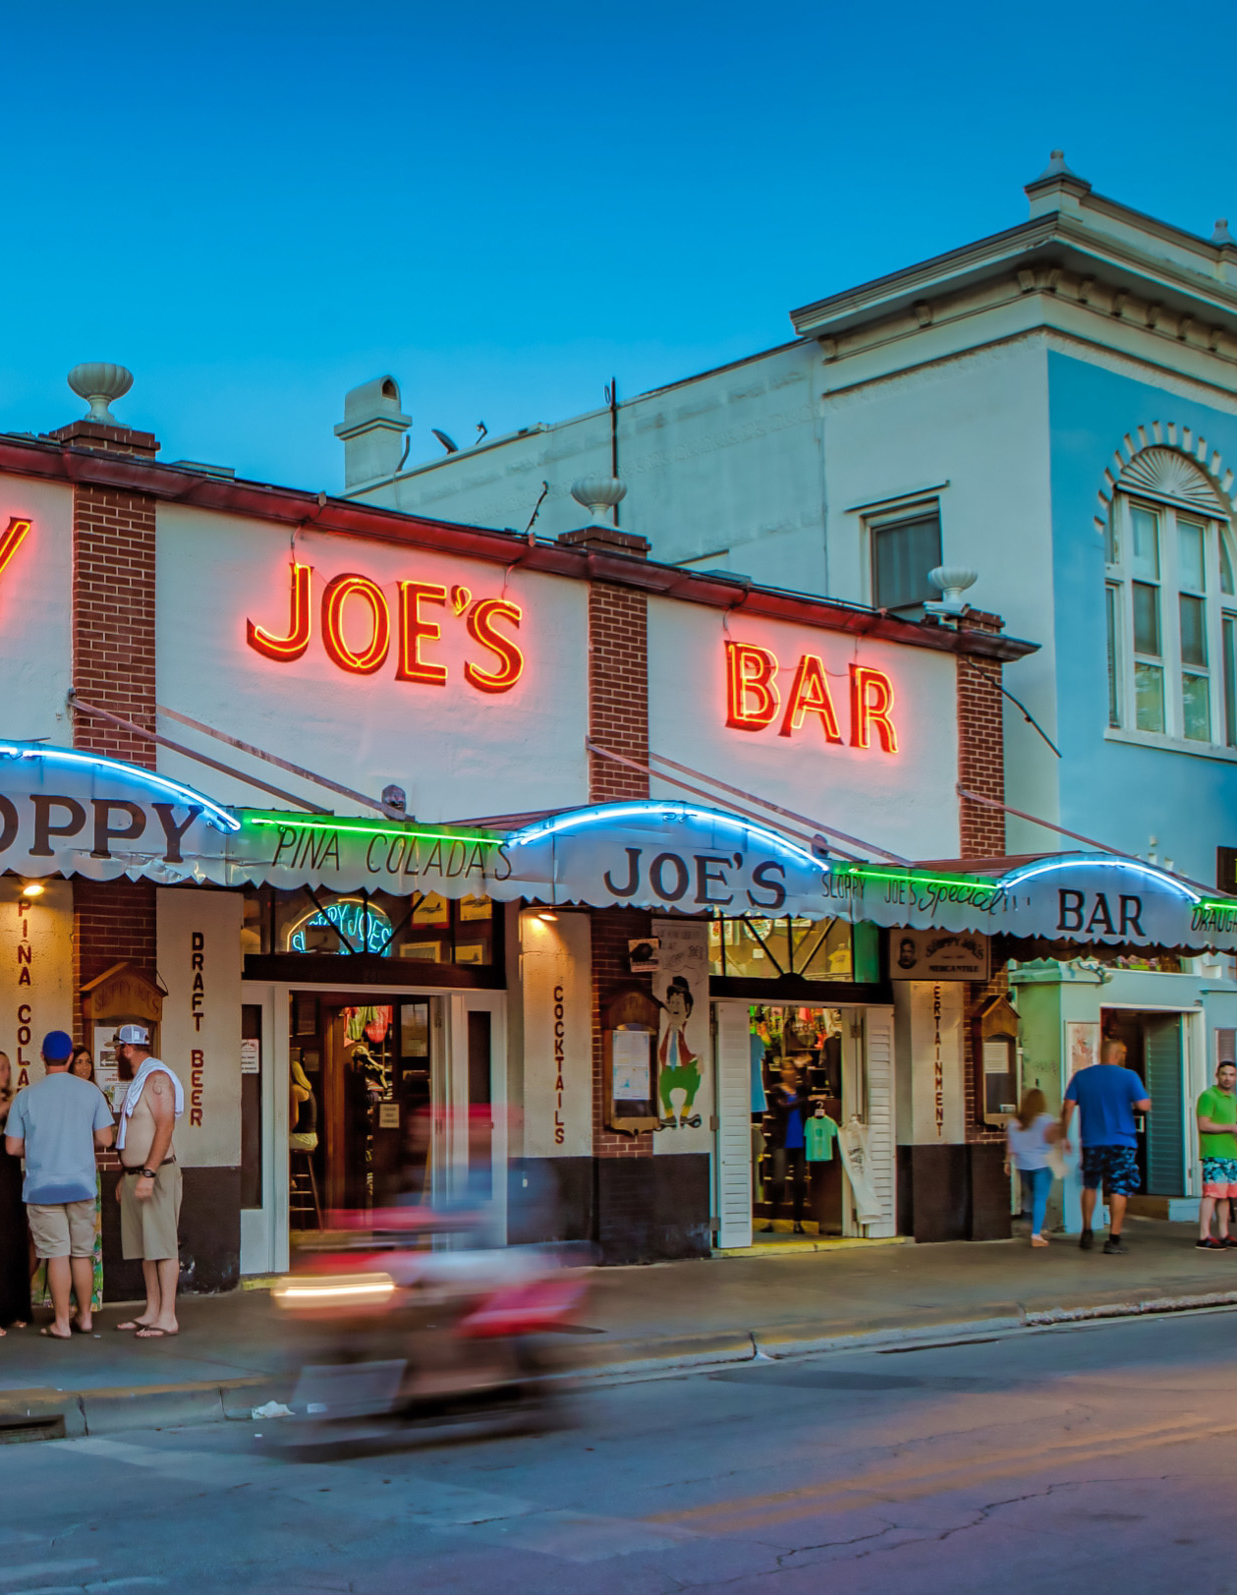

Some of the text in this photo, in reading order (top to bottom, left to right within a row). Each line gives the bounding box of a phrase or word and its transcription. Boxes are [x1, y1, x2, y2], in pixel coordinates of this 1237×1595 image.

[247, 562, 524, 694] JOE'S
[724, 641, 899, 754] BAR
[365, 833, 513, 881] COLADA'S
[603, 847, 787, 910] JOE'S
[821, 873, 866, 900] SLOPPY
[1056, 888, 1146, 937] BAR
[17, 1004, 31, 1094] COLA
[190, 932, 204, 1127] DRAFT BEER
[553, 985, 565, 1144] COCKTAILS
[934, 981, 944, 1137] ERTAINMENT
